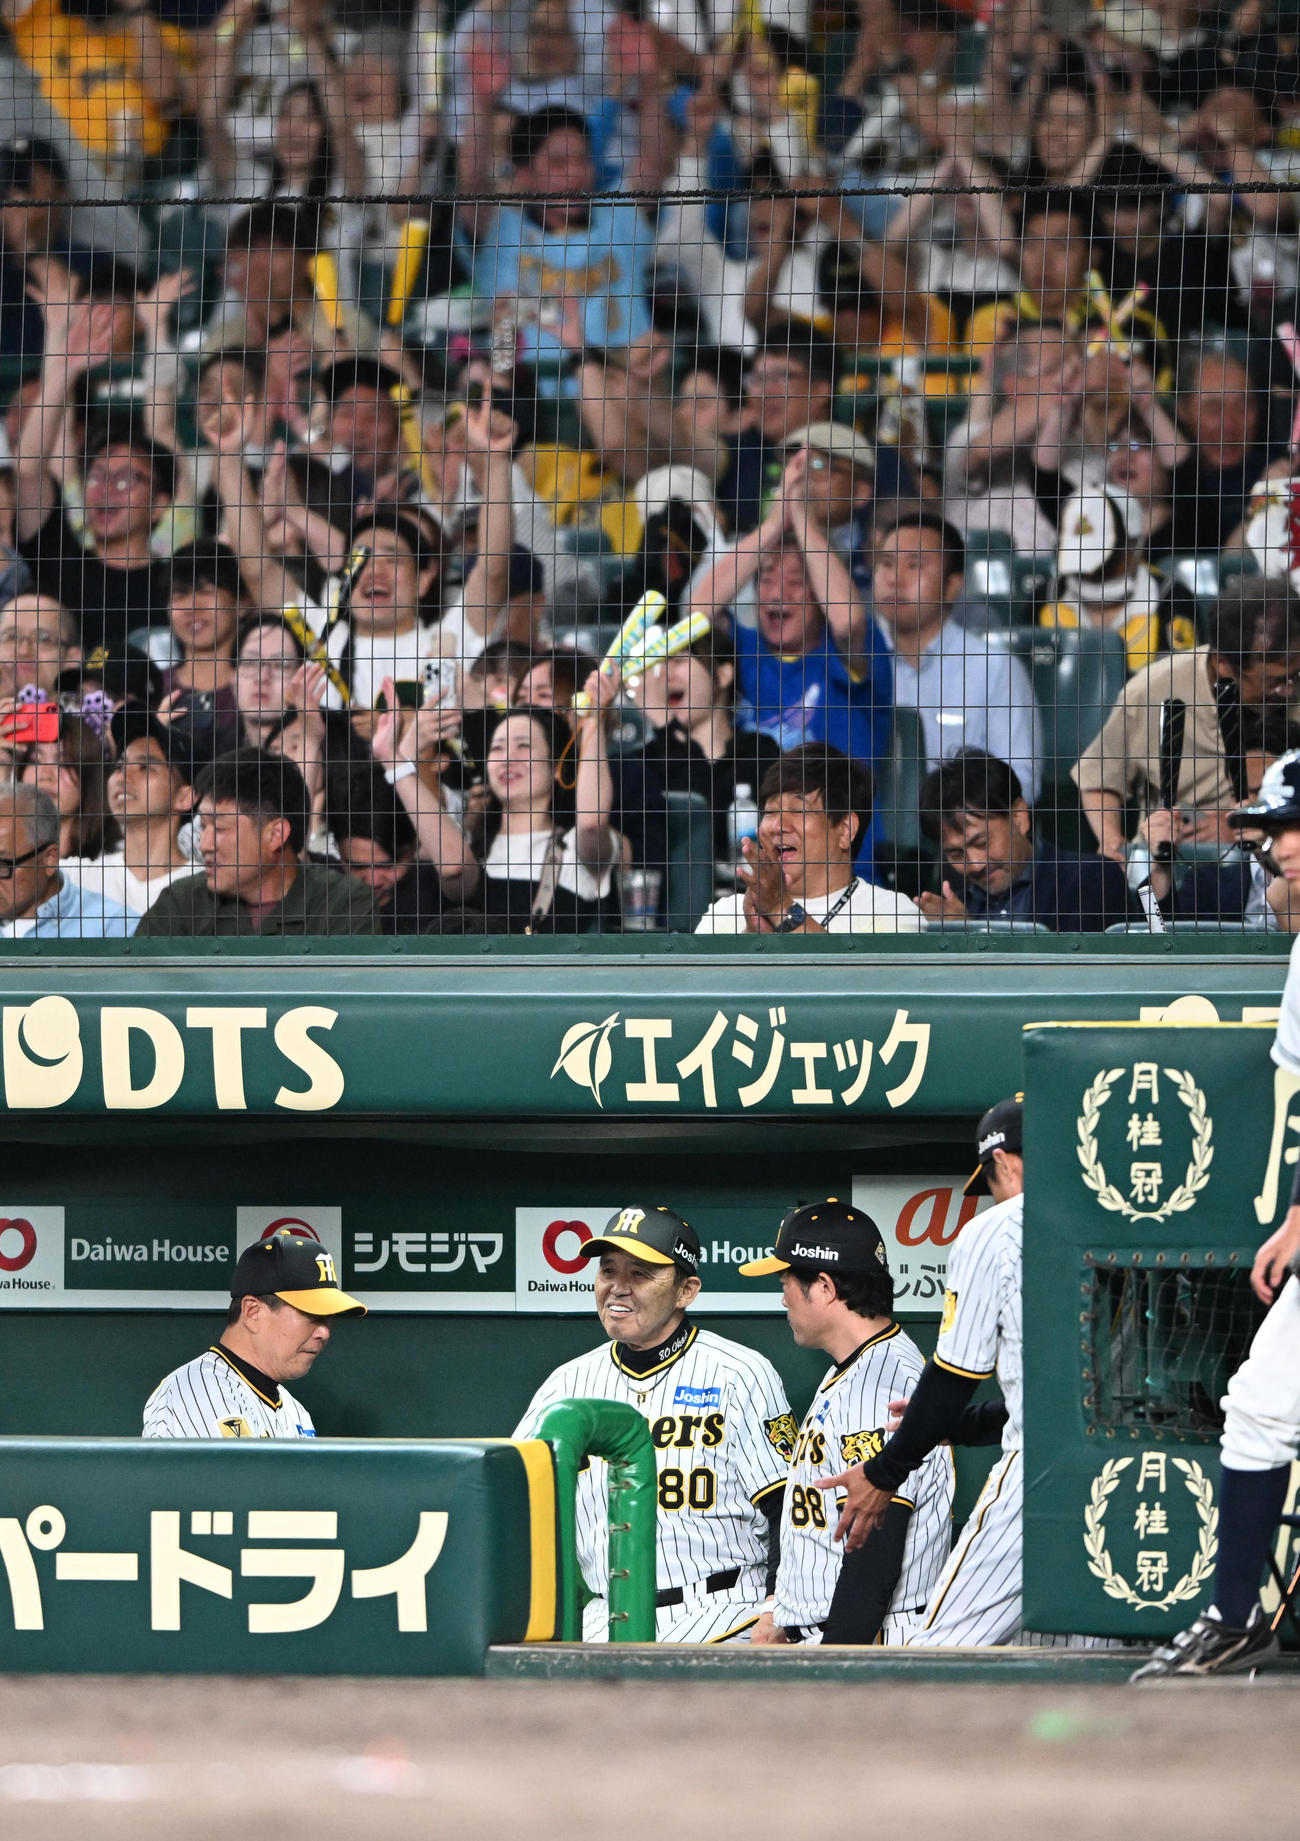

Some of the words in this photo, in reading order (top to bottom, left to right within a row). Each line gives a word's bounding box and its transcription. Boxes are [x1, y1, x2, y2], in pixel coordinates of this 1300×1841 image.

[625, 1006, 931, 1109] エイジェック
[1126, 1062, 1164, 1204] 月桂冠
[71, 1236, 149, 1262] Daiwa
[152, 1238, 229, 1262] House
[354, 1232, 504, 1273] シモジマ
[674, 1243, 699, 1270] Josh
[711, 1240, 775, 1264] Hous
[791, 1243, 839, 1261] Joshin
[12, 1278, 51, 1290] House
[528, 1280, 566, 1292] Daiwa
[569, 1280, 595, 1292] Hou
[658, 1346, 671, 1361] 80
[675, 1388, 719, 1405] Joshin
[650, 1411, 726, 1450] ers
[658, 1466, 716, 1512] 80
[790, 1482, 828, 1530] 88
[1133, 1451, 1169, 1593] 月桂冠
